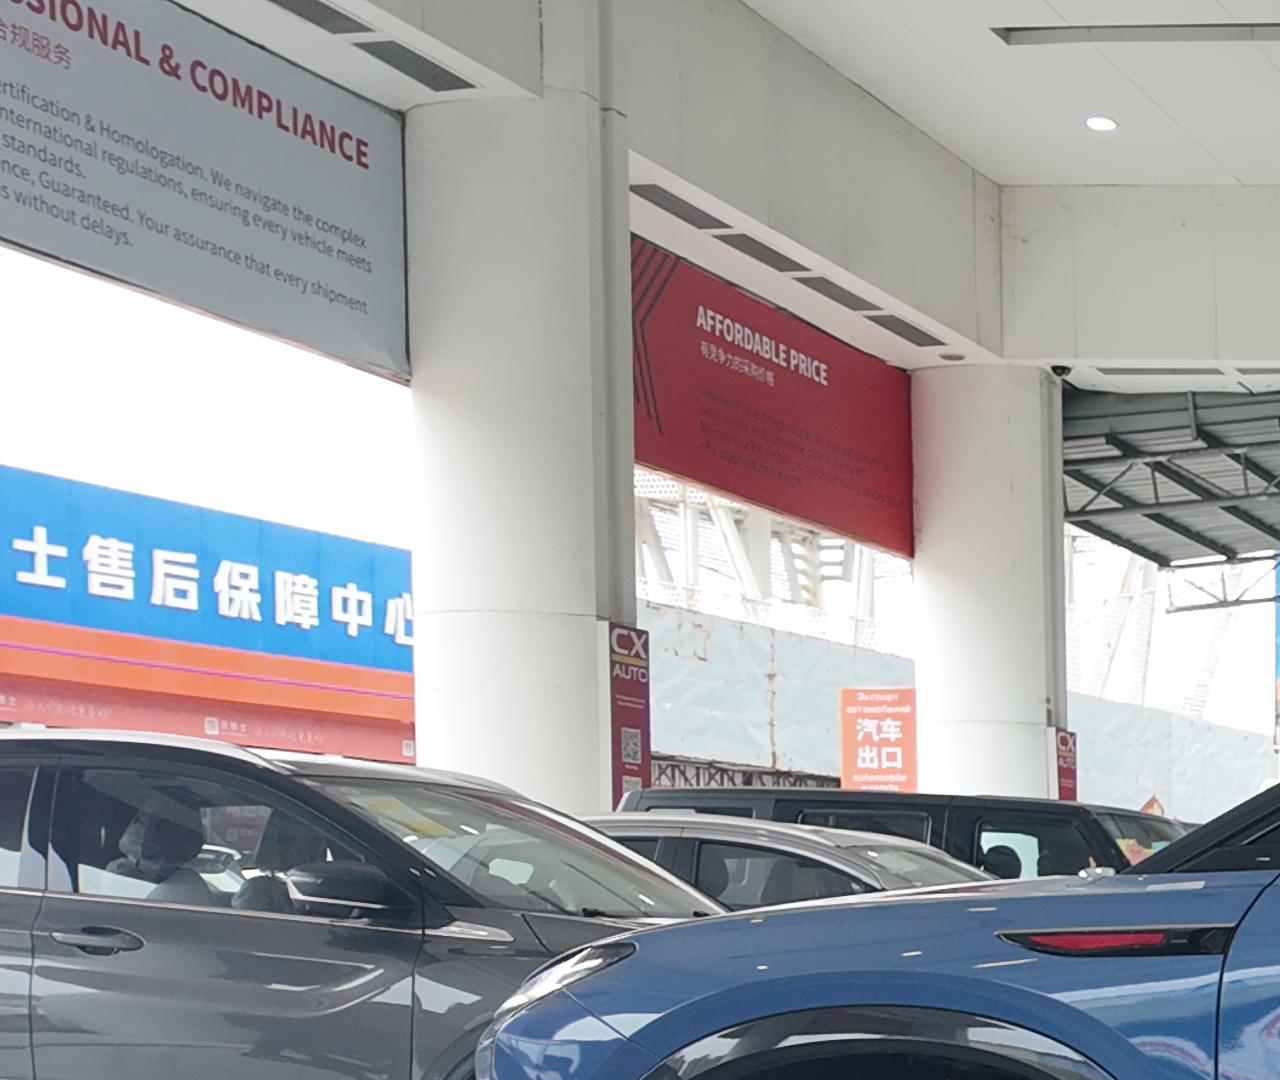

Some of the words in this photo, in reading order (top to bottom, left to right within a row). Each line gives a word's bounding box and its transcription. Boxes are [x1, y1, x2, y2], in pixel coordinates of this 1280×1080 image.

[10, 0, 151, 67] IONAL
[159, 44, 182, 81] &
[190, 59, 370, 170] COMPLIANCE
[2, 133, 87, 180] standards.
[85, 114, 96, 133] &
[99, 120, 208, 182] Homologation.
[210, 168, 232, 193] We
[235, 183, 290, 222] navigate
[293, 206, 313, 230] the
[315, 219, 367, 249] complex
[12, 185, 78, 227] without
[80, 213, 134, 247] delays.
[38, 170, 135, 224] Guaranteed.
[136, 208, 170, 237] Your
[173, 226, 242, 266] assurance
[244, 253, 272, 278] that
[273, 267, 308, 295] every
[310, 280, 369, 315] shipment
[101, 149, 188, 200] regulations,
[190, 186, 250, 228] ensuring
[252, 212, 288, 243] every
[290, 229, 334, 259] vehicle
[336, 247, 373, 274] meets
[696, 305, 788, 368] AFFORDABLE
[789, 348, 829, 386] PRICE
[12, 526, 414, 646] 士售后保障中心
[611, 627, 647, 659] CX
[612, 663, 648, 683] AUTO
[855, 717, 903, 743] 汽车
[856, 745, 903, 769] 出口
[1056, 731, 1076, 752] CX
